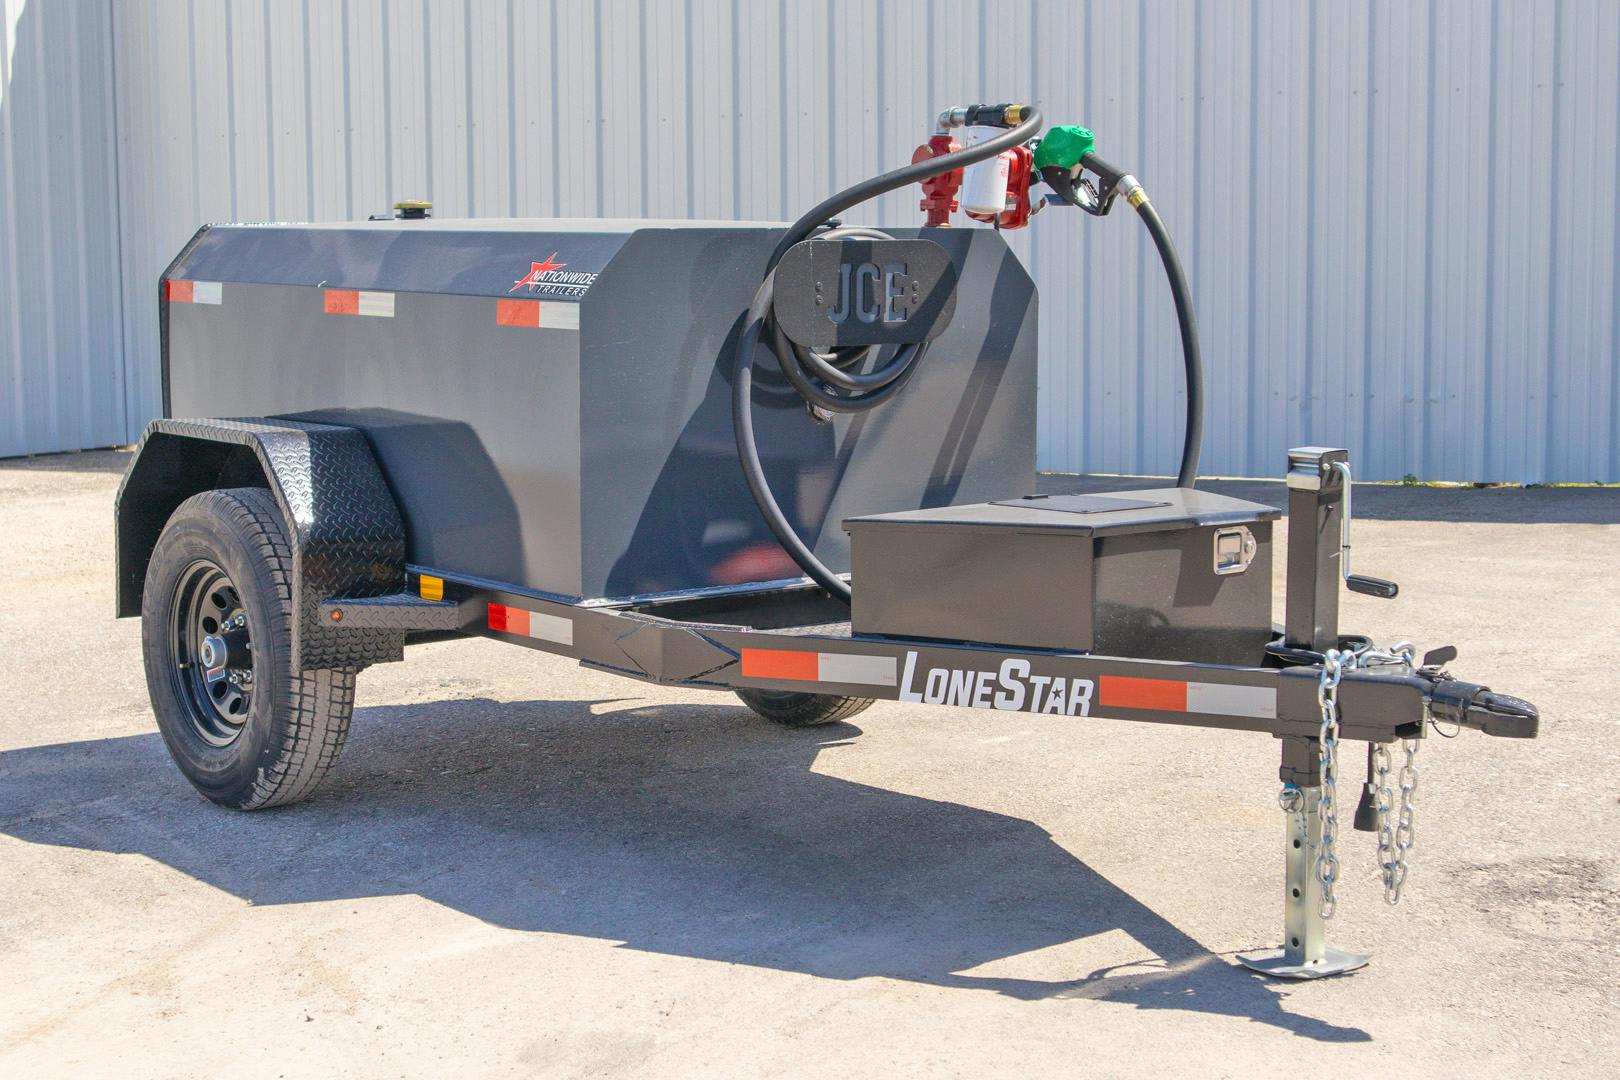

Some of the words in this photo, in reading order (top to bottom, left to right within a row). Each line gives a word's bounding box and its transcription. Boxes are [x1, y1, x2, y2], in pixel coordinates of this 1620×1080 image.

[530, 269, 599, 285] NATIONWIDE
[536, 285, 587, 297] TRAILERS
[826, 262, 908, 324] JCE
